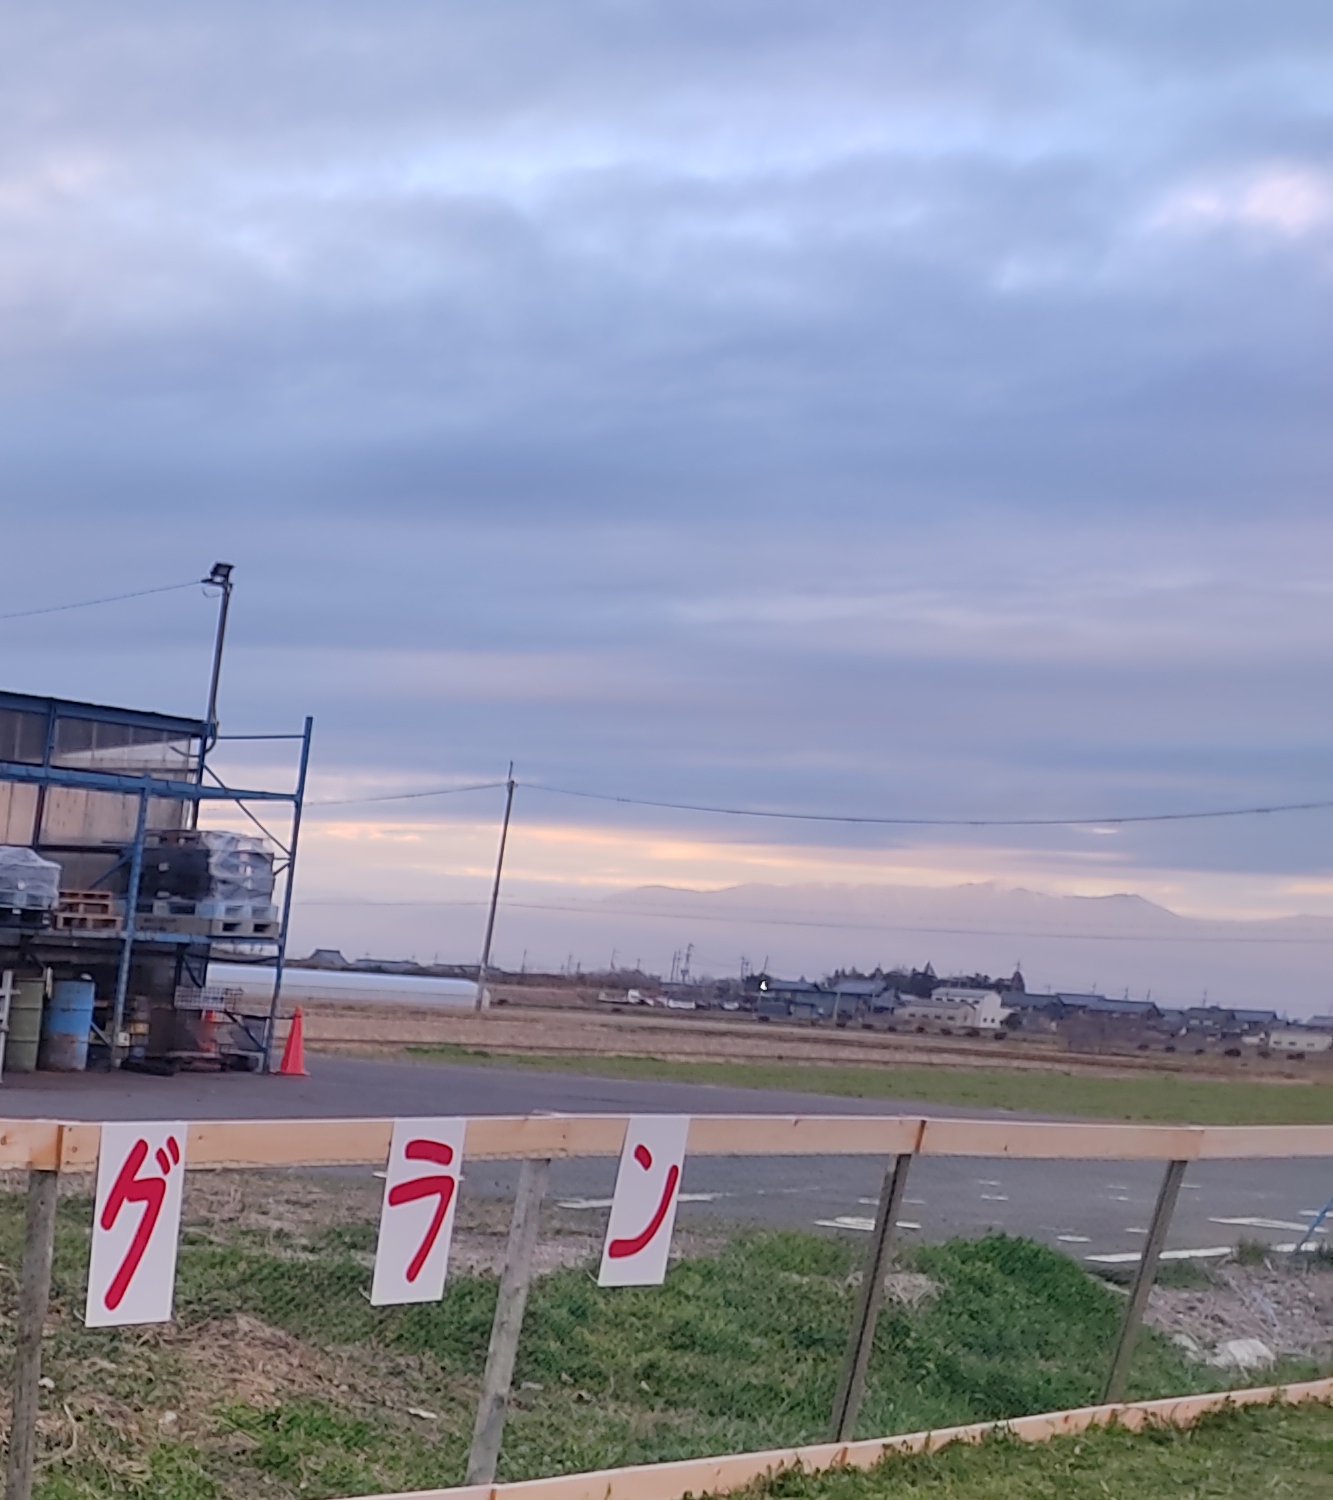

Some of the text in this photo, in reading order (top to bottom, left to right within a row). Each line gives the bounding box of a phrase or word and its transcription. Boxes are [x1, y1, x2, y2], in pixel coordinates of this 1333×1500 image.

[100, 1136, 178, 1311] グ
[388, 1139, 455, 1283] ラ
[608, 1144, 679, 1259] ン
